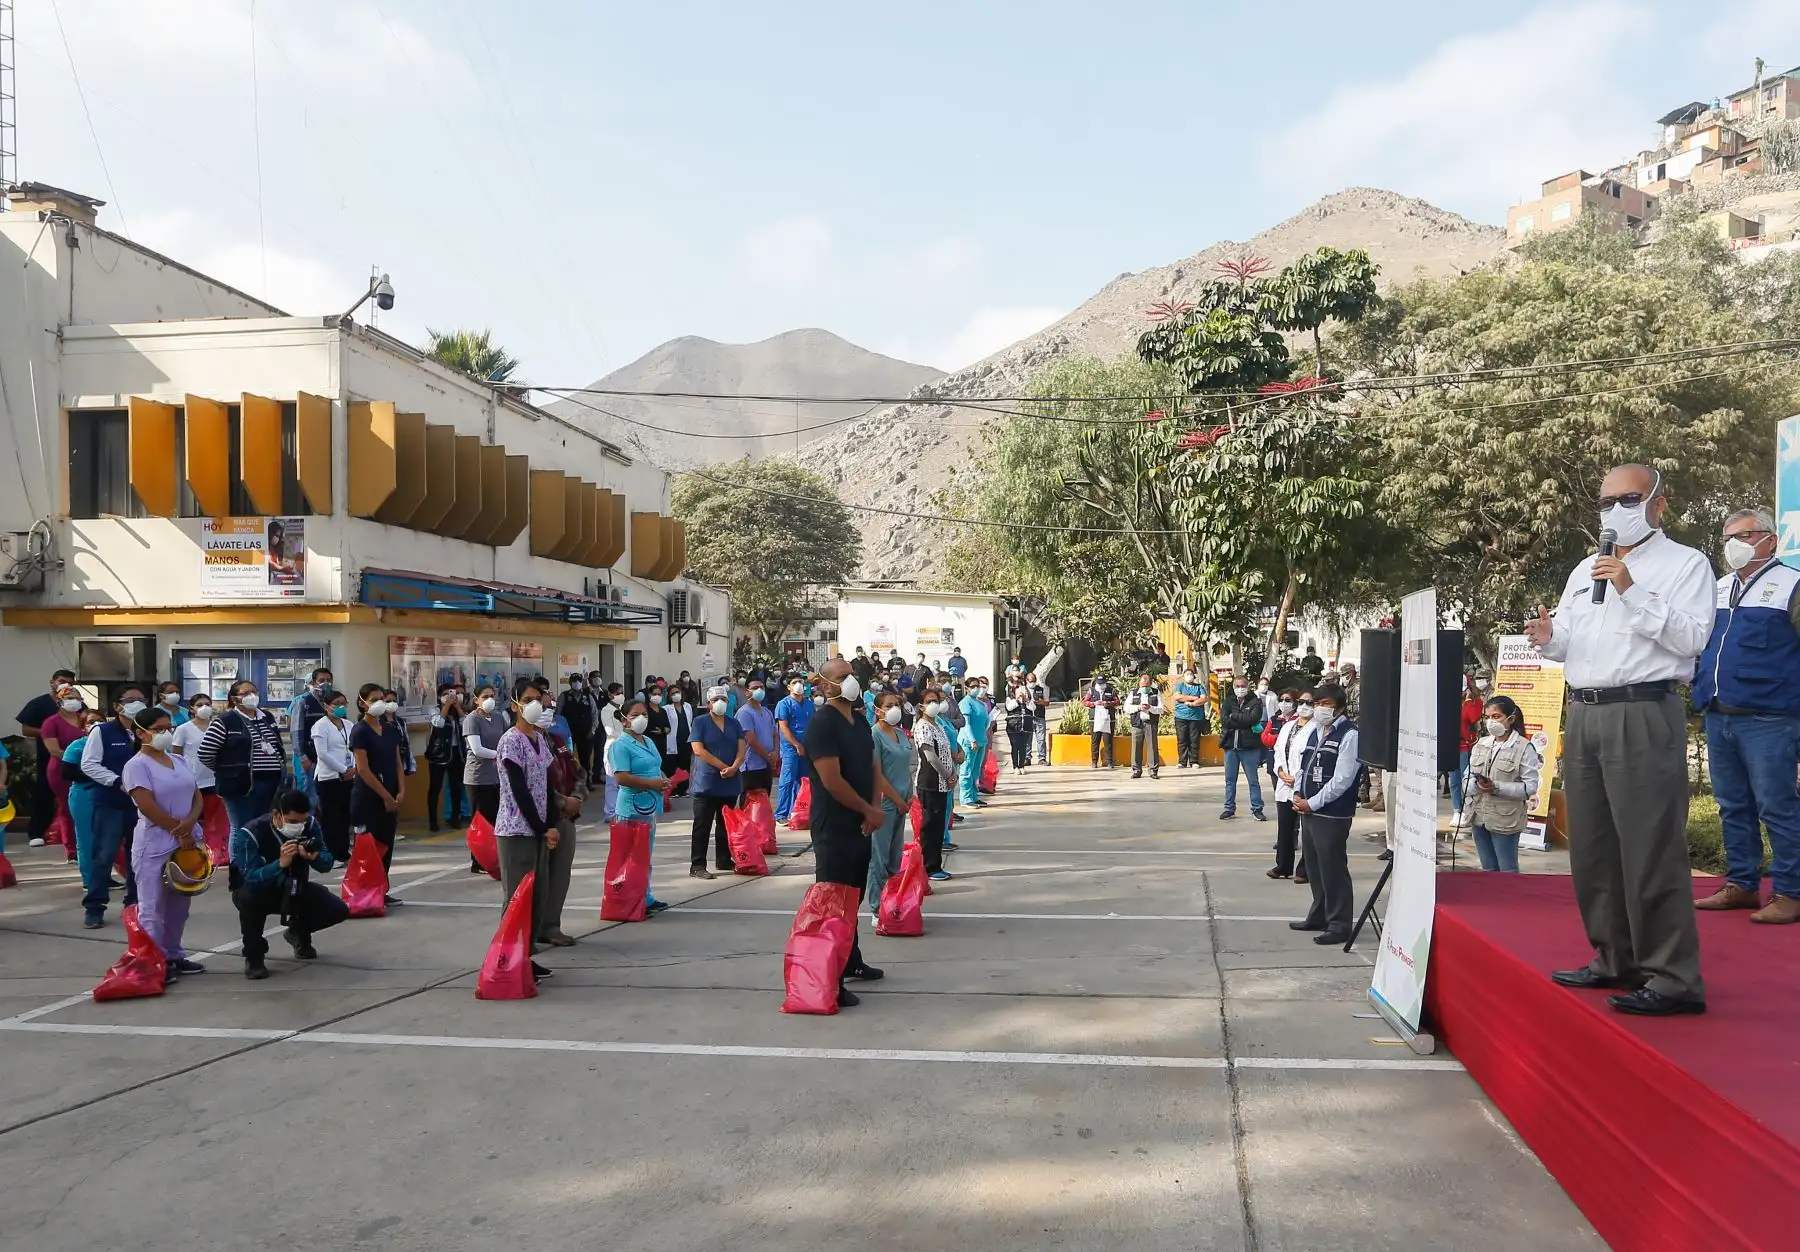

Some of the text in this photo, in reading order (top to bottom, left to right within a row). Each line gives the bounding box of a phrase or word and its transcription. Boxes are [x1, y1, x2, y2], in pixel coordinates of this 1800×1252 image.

[204, 523, 223, 531] HOY
[207, 541, 262, 549] LÁVATE LAS
[205, 556, 240, 565] MANOS
[1502, 652, 1545, 660] CORONAV
